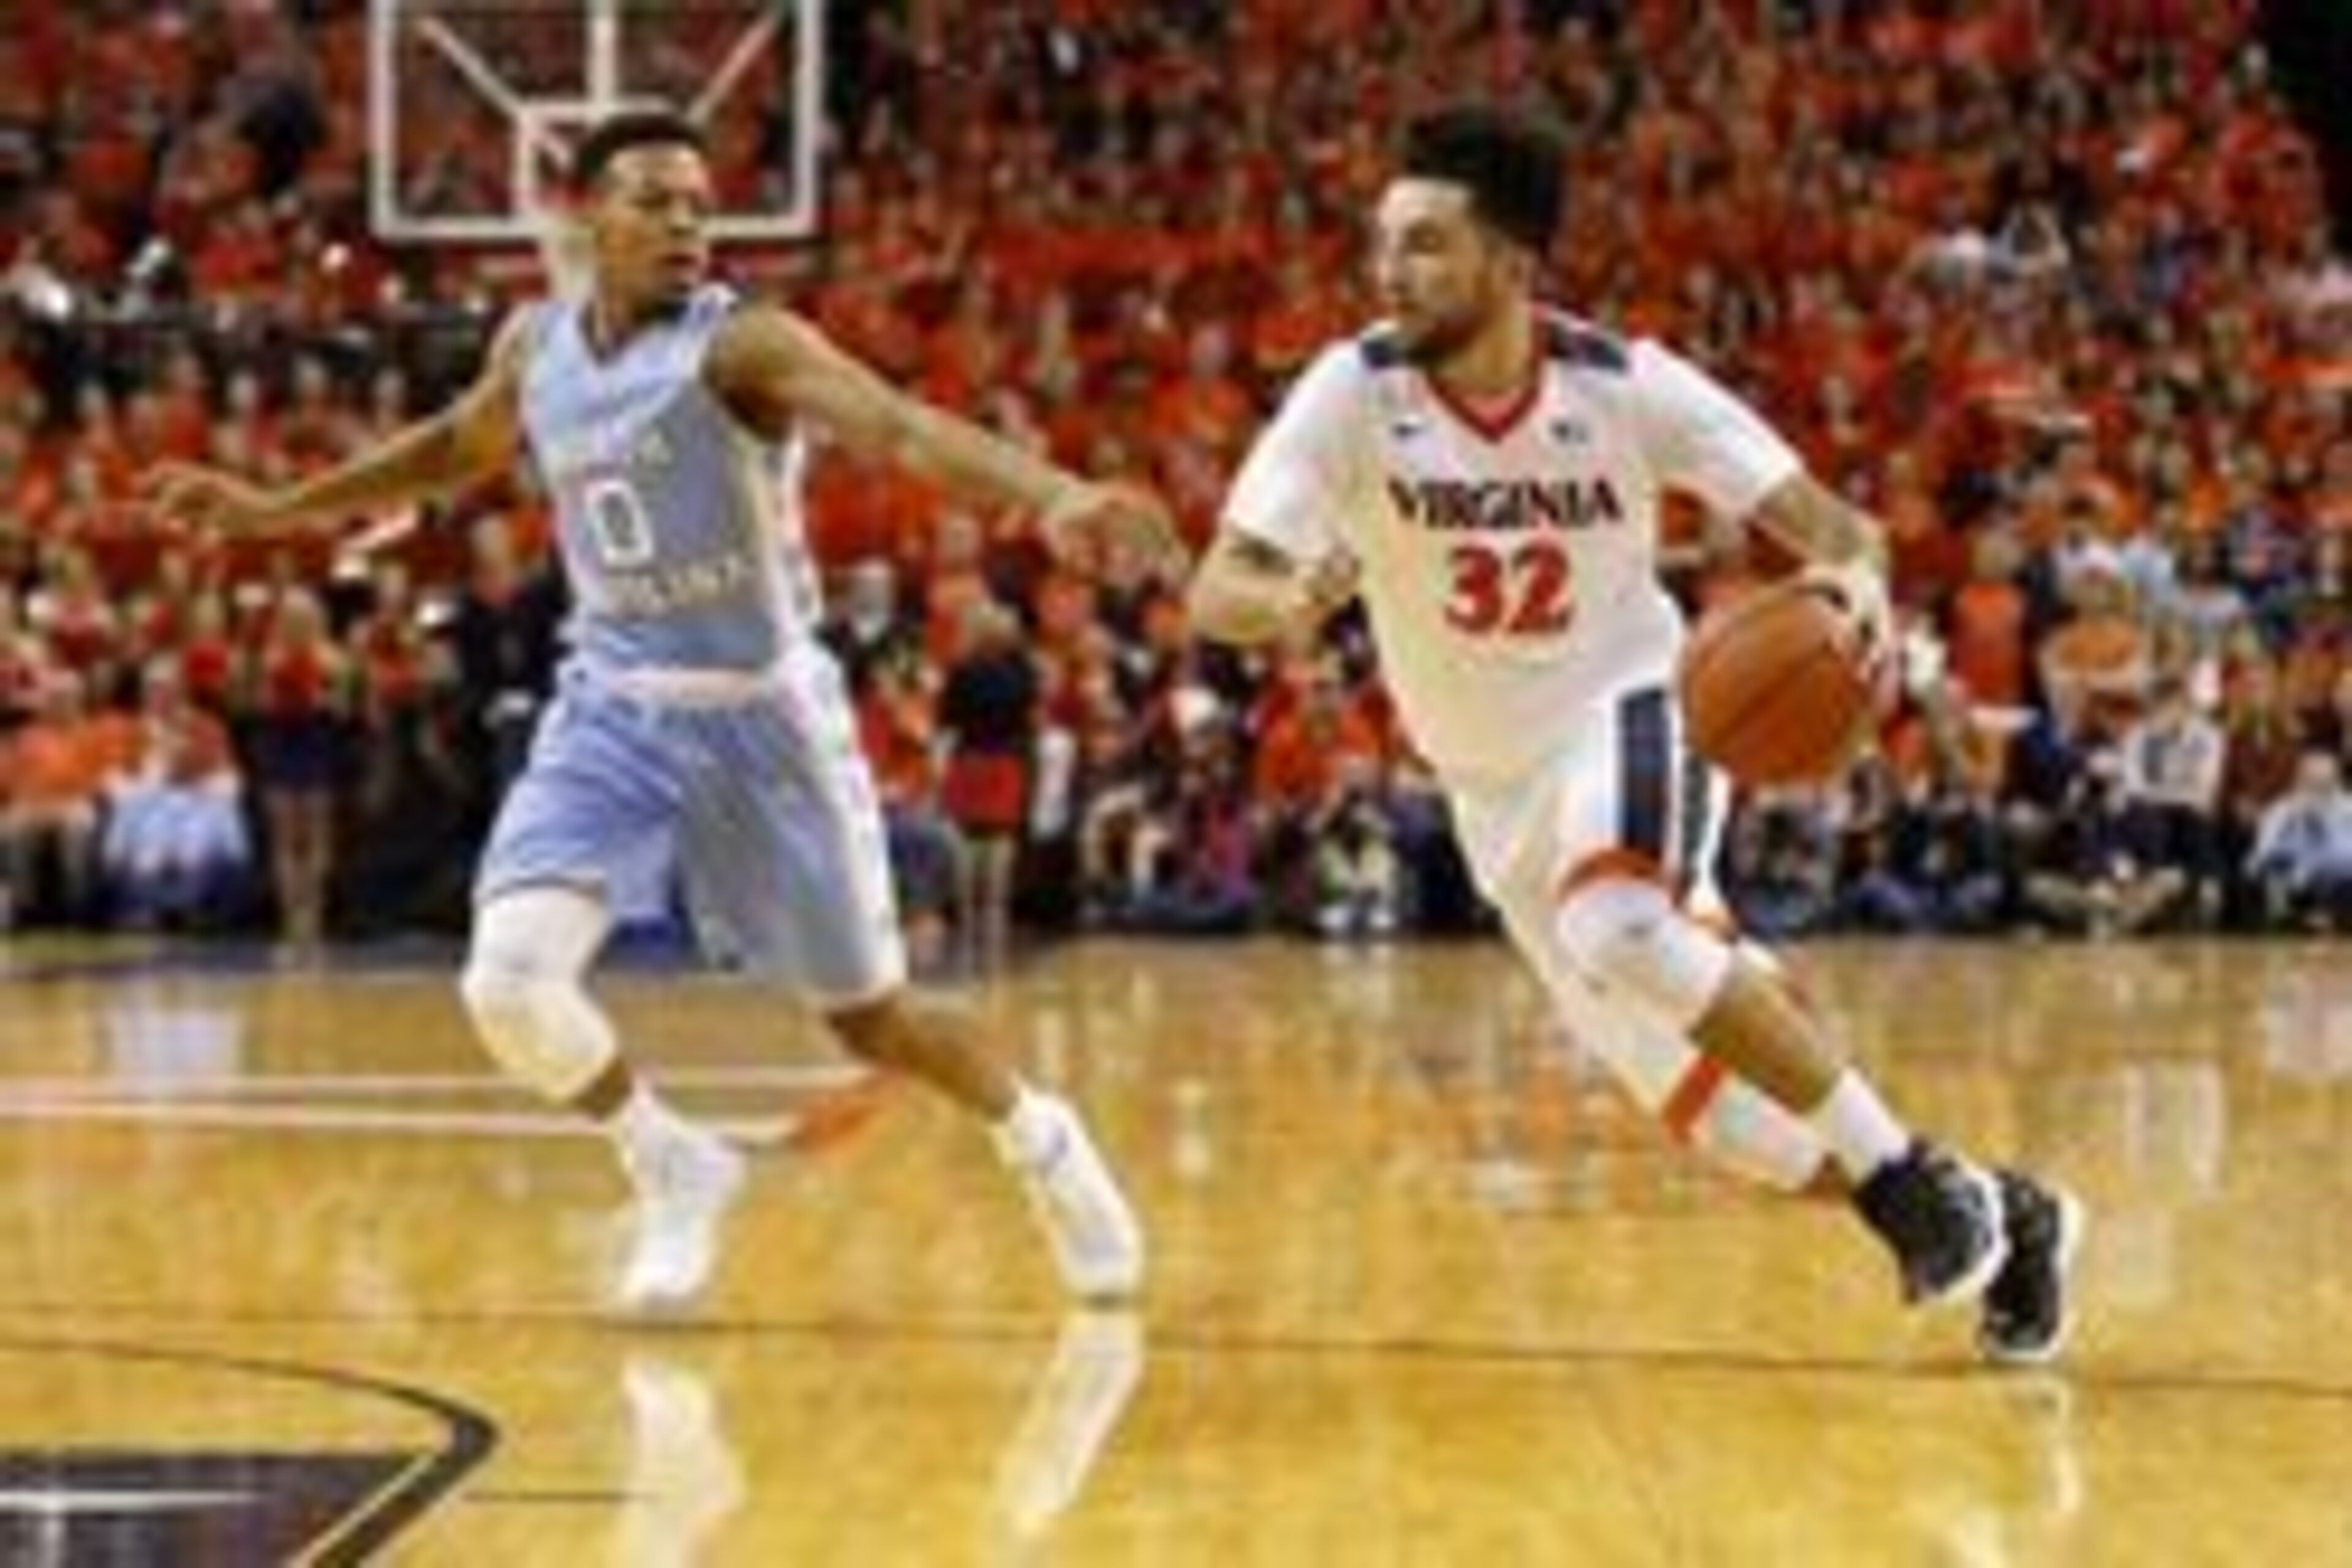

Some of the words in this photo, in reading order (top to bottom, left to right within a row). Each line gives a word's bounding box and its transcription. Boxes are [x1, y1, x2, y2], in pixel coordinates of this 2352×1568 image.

[586, 479, 654, 568] 0
[1386, 478, 1625, 530] VIRGINIA
[1444, 545, 1575, 635] 32
